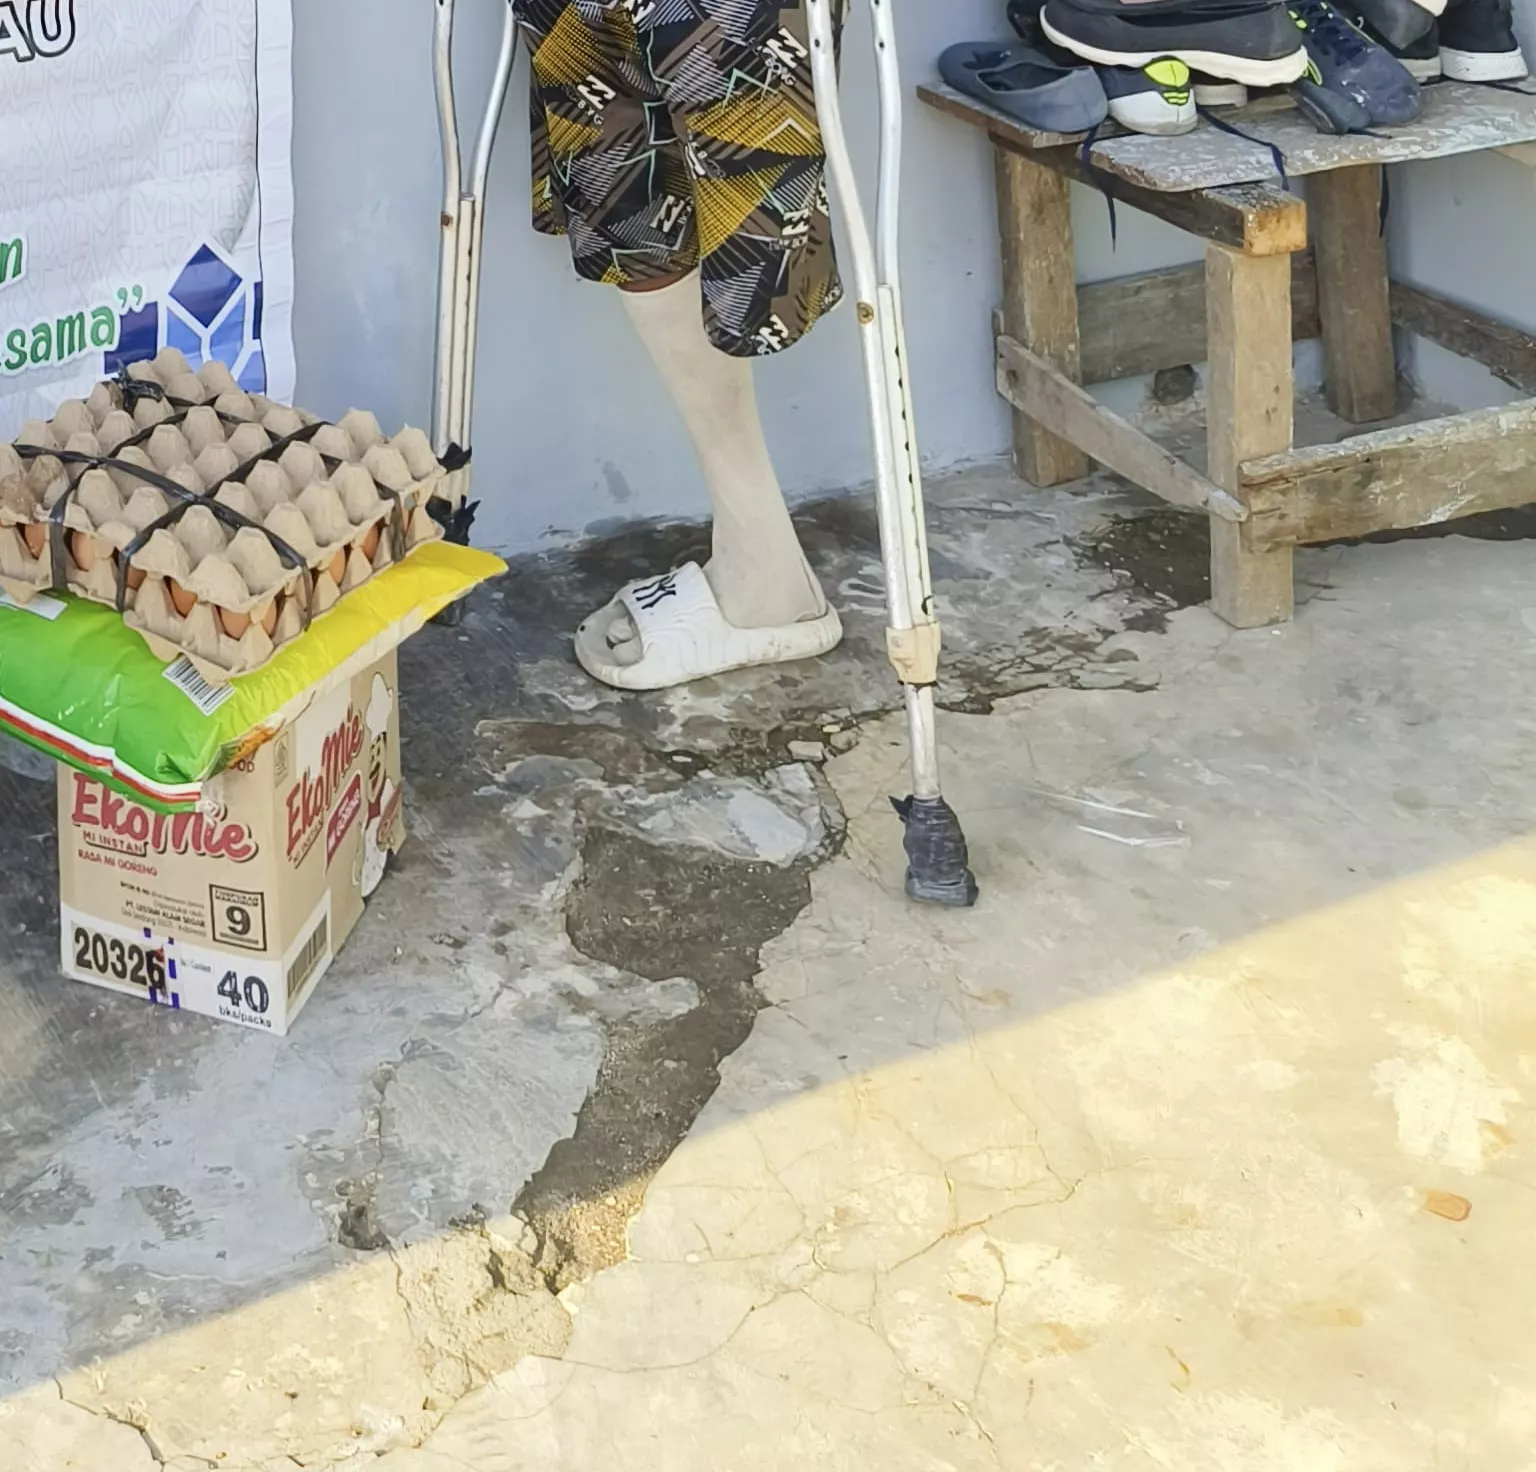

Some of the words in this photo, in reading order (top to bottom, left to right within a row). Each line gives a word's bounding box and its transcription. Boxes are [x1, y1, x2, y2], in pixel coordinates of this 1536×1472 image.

[99, 834, 144, 853] INSTAN
[78, 849, 102, 864] RASA
[118, 858, 158, 877] GORENG
[225, 905, 252, 936] 9
[217, 970, 270, 1014] 40
